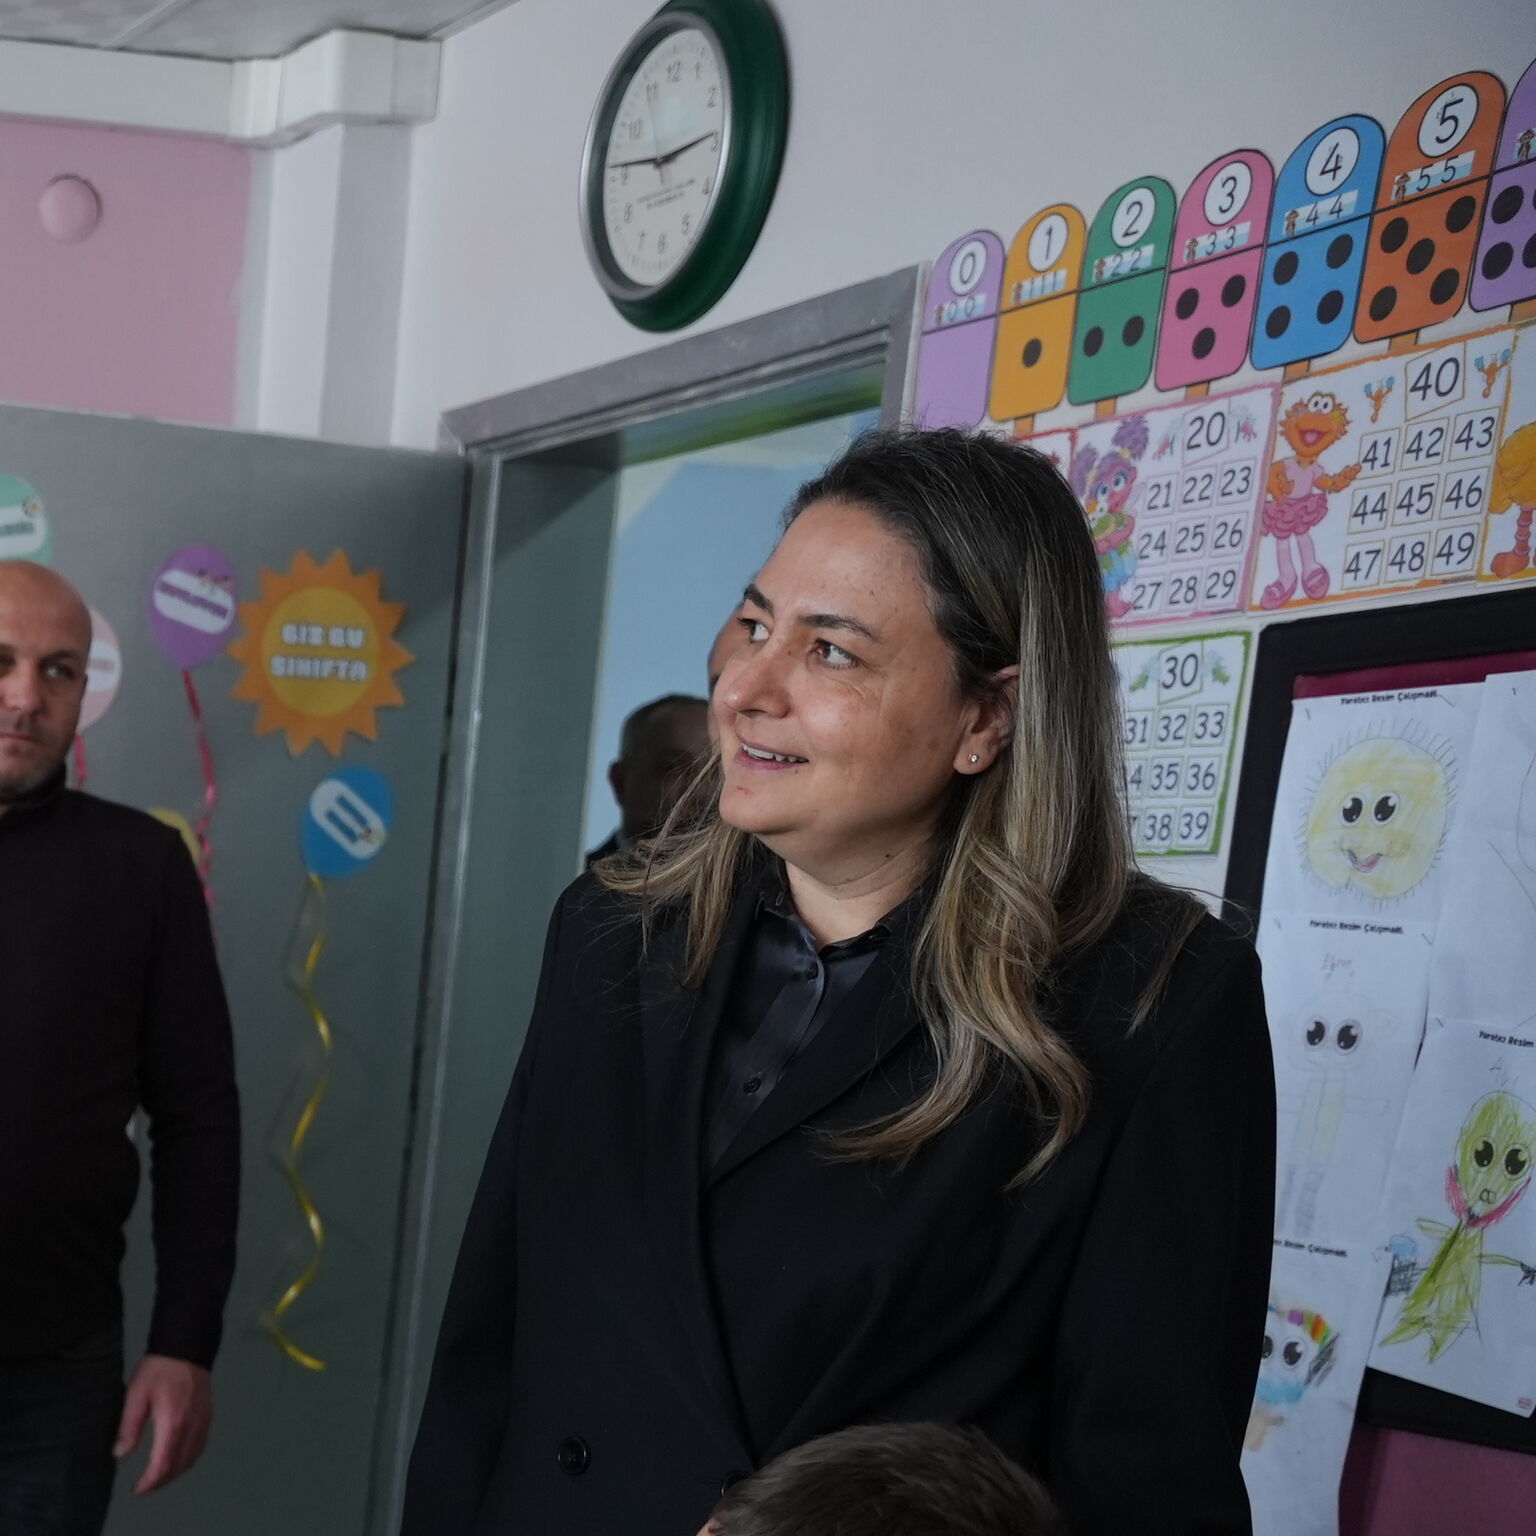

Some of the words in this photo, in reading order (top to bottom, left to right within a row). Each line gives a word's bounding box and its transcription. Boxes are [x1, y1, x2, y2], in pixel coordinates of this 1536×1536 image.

[666, 61, 682, 82] 12
[707, 86, 717, 109] 2
[629, 118, 643, 139] 10
[1435, 97, 1465, 145] 5
[1319, 142, 1343, 182] 4
[1415, 164, 1434, 192] 5
[1440, 155, 1460, 184] 5
[702, 176, 712, 195] 4
[1218, 175, 1238, 214] 3
[1122, 200, 1144, 239] 2
[1305, 201, 1320, 226] 4
[1328, 194, 1344, 220] 4
[1045, 225, 1054, 262] 1
[1205, 232, 1218, 256] 3
[1223, 226, 1237, 250] 3
[959, 251, 977, 286] 0
[1109, 253, 1124, 278] 2
[1129, 248, 1143, 273] 2
[946, 298, 959, 322] 0
[965, 296, 977, 318] 0
[1409, 356, 1461, 402] 40
[1186, 410, 1227, 451] 20
[1361, 436, 1393, 471] 41
[1405, 426, 1445, 462] 42
[1454, 415, 1496, 452] 43
[1146, 479, 1173, 511] 21
[1182, 473, 1214, 505] 22
[1220, 466, 1252, 497] 23
[1351, 490, 1388, 526] 44
[1395, 482, 1436, 517] 45
[1444, 474, 1483, 511] 46
[1138, 530, 1167, 561] 24
[1175, 523, 1207, 555] 25
[1213, 518, 1243, 550] 26
[1344, 548, 1382, 582] 47
[1388, 540, 1426, 574] 48
[1435, 531, 1476, 566] 49
[1132, 582, 1163, 611] 27
[1168, 576, 1198, 606] 28
[1205, 569, 1237, 600] 29
[270, 655, 368, 682] SINIFTA
[1161, 653, 1199, 690] 30
[1372, 694, 1395, 703] Resim
[1124, 716, 1149, 745] 31
[1157, 713, 1188, 742] 32
[1194, 711, 1226, 740] 33
[1151, 762, 1180, 791] 35
[1187, 761, 1216, 791] 36
[1143, 813, 1172, 841] 38
[1180, 811, 1210, 841] 39
[1508, 1036, 1534, 1048] Resim
